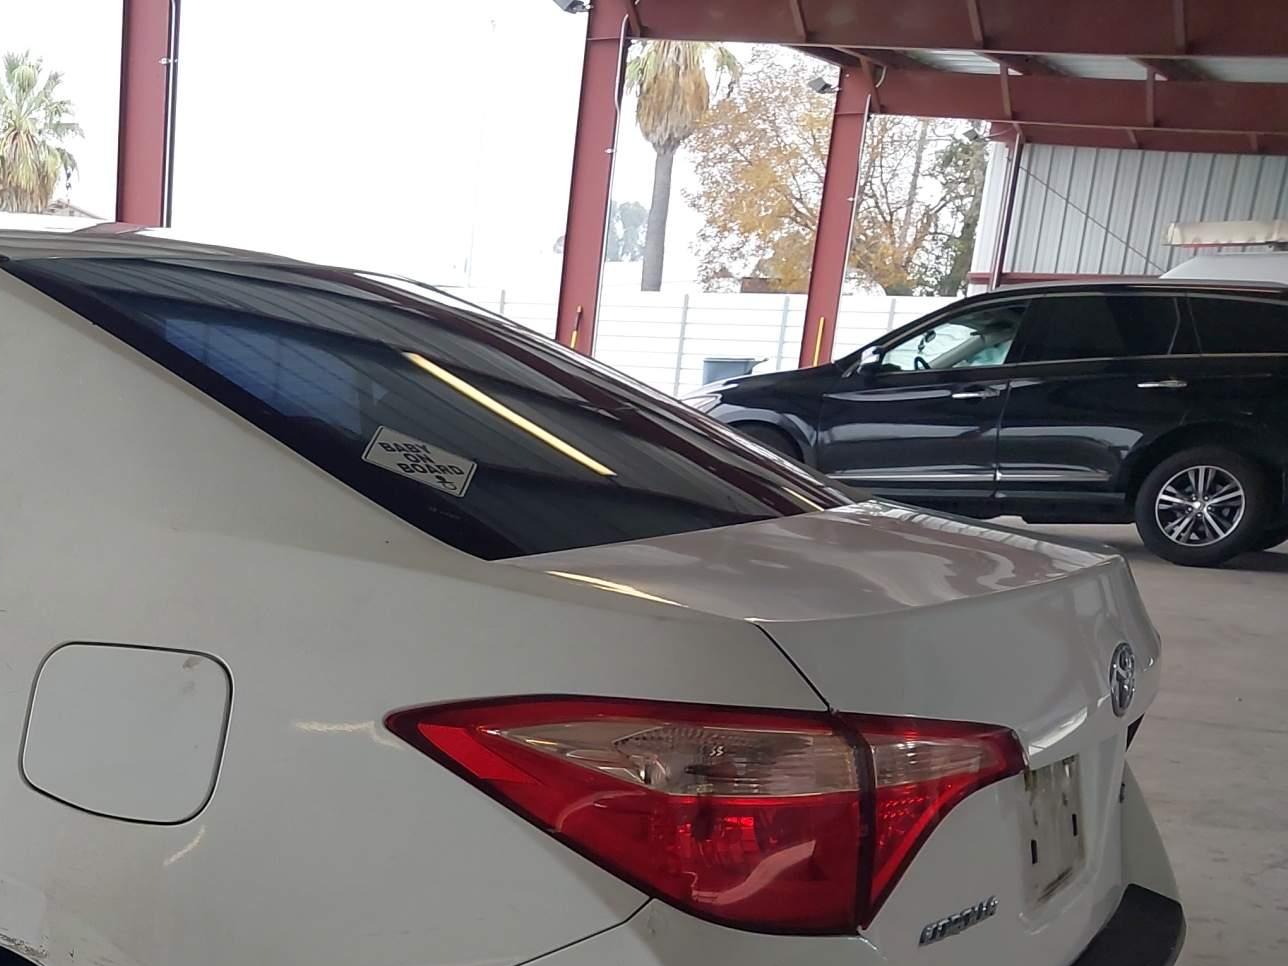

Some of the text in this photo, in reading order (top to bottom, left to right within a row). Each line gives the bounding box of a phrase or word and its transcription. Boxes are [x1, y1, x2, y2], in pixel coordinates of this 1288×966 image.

[378, 442, 431, 454] BABY
[403, 453, 436, 464] ON
[397, 463, 465, 475] BOARD
